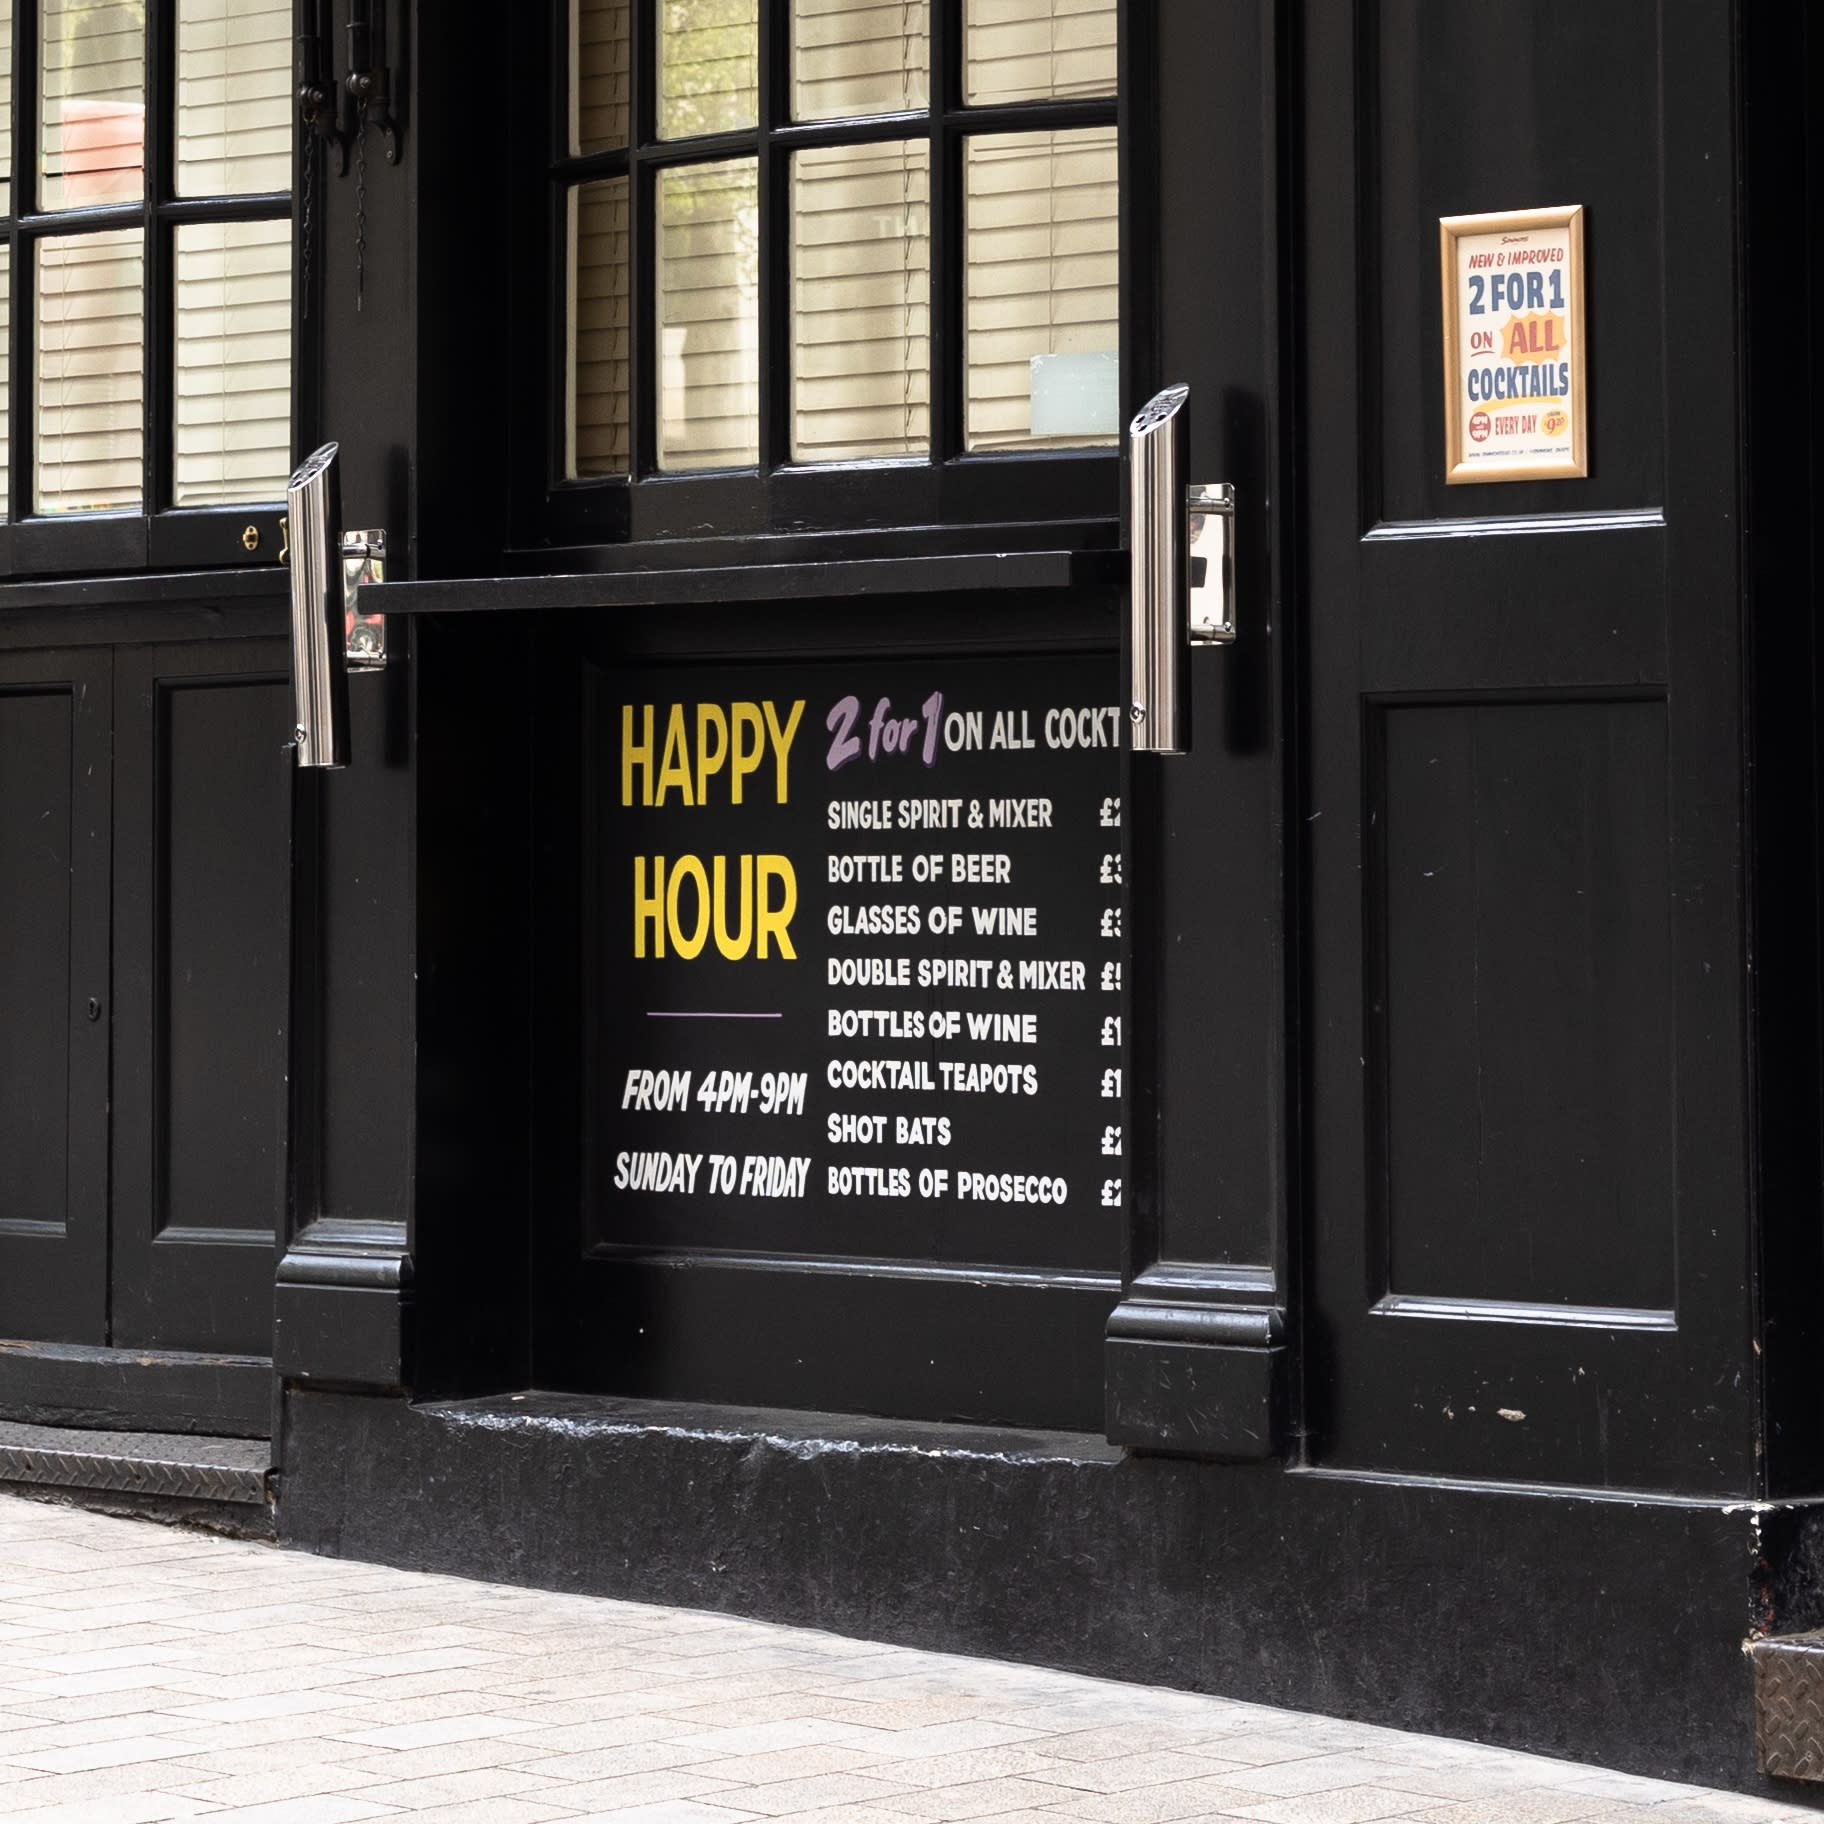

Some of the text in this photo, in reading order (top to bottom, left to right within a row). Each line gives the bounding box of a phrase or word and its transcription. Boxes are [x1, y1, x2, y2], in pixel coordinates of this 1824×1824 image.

[1469, 247, 1564, 269] NEW & IMPROVED
[1468, 269, 1565, 315] 2 FOR 1
[1470, 319, 1560, 354] ON ALL
[1468, 362, 1568, 401] COCKTAILS
[1495, 415, 1537, 435] EVERY DAY
[826, 695, 861, 771] 2
[868, 697, 918, 763] for
[922, 691, 943, 768] 1
[944, 711, 983, 752] ON
[989, 710, 1036, 750] ALL
[621, 699, 806, 807] HAPPY
[828, 800, 892, 829] SINGLE
[897, 799, 963, 829] SPIRIT
[967, 799, 984, 829] &
[989, 798, 1053, 828] MIXER
[828, 855, 903, 884] BOTTLE
[912, 854, 944, 883] OF
[951, 854, 1012, 884] BEER
[634, 854, 798, 961] HOUR
[828, 905, 921, 936] GLASSES
[928, 905, 963, 935] OF
[972, 907, 1038, 937] WINE
[828, 958, 911, 988] DOUBLE
[917, 959, 992, 989] SPIRIT
[996, 960, 1014, 990] &
[1019, 961, 1086, 991] MIXER
[828, 1009, 926, 1039] BOTTLES
[928, 1011, 961, 1040] OF
[966, 1012, 1038, 1043] WINE
[621, 1069, 808, 1116] FROM 4PM-9PM
[828, 1060, 935, 1090] COCKTAIL
[939, 1062, 1038, 1096] TEAPOTS
[828, 1113, 887, 1144] SHOT
[895, 1116, 952, 1146] BATS
[613, 1151, 812, 1198] SUNDAY TO FRIDAY
[828, 1167, 911, 1198] BOTTLES
[918, 1168, 949, 1198] OF
[957, 1171, 1068, 1205] PROSECCO
